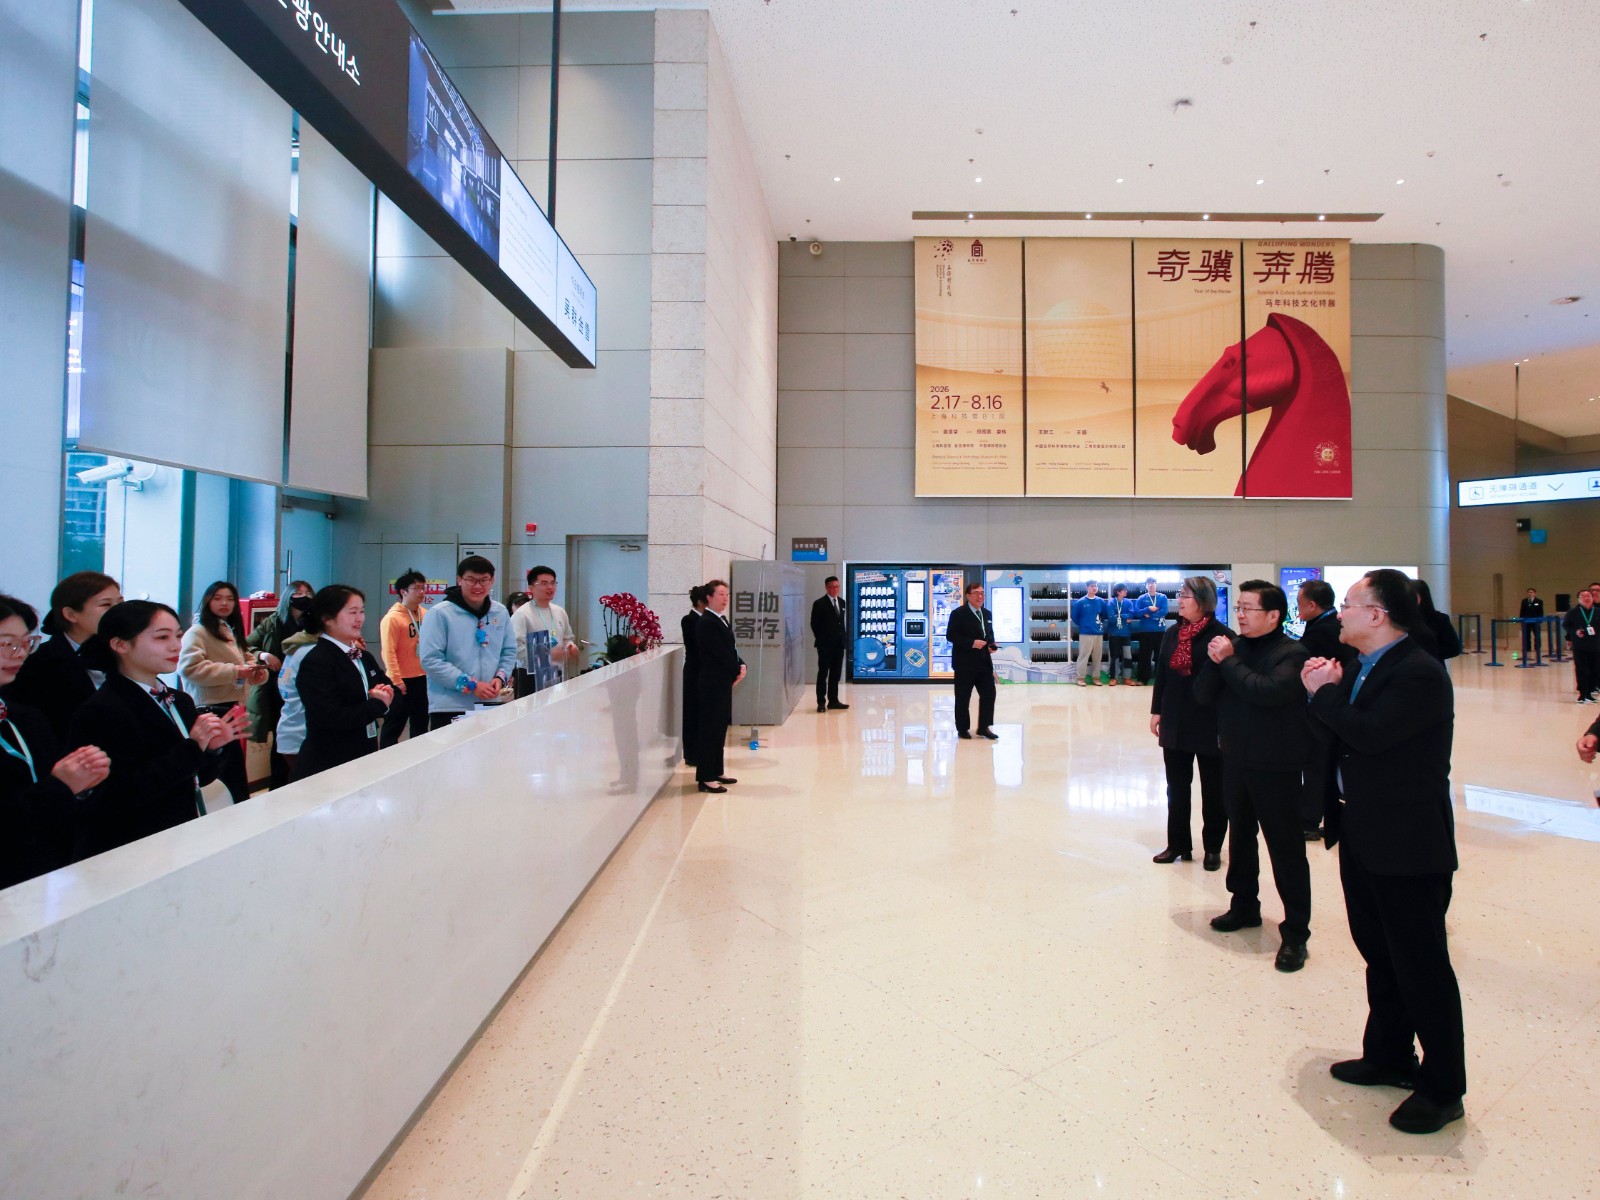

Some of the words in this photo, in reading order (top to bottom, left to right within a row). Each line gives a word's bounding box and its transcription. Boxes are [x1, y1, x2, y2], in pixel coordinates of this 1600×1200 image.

[278, 0, 361, 86] 광안내소
[1265, 299, 1336, 307] 马年科技文化特展
[1489, 482, 1537, 492] 无障碍通道
[735, 591, 779, 613] 自助
[734, 617, 780, 640] 寄存
